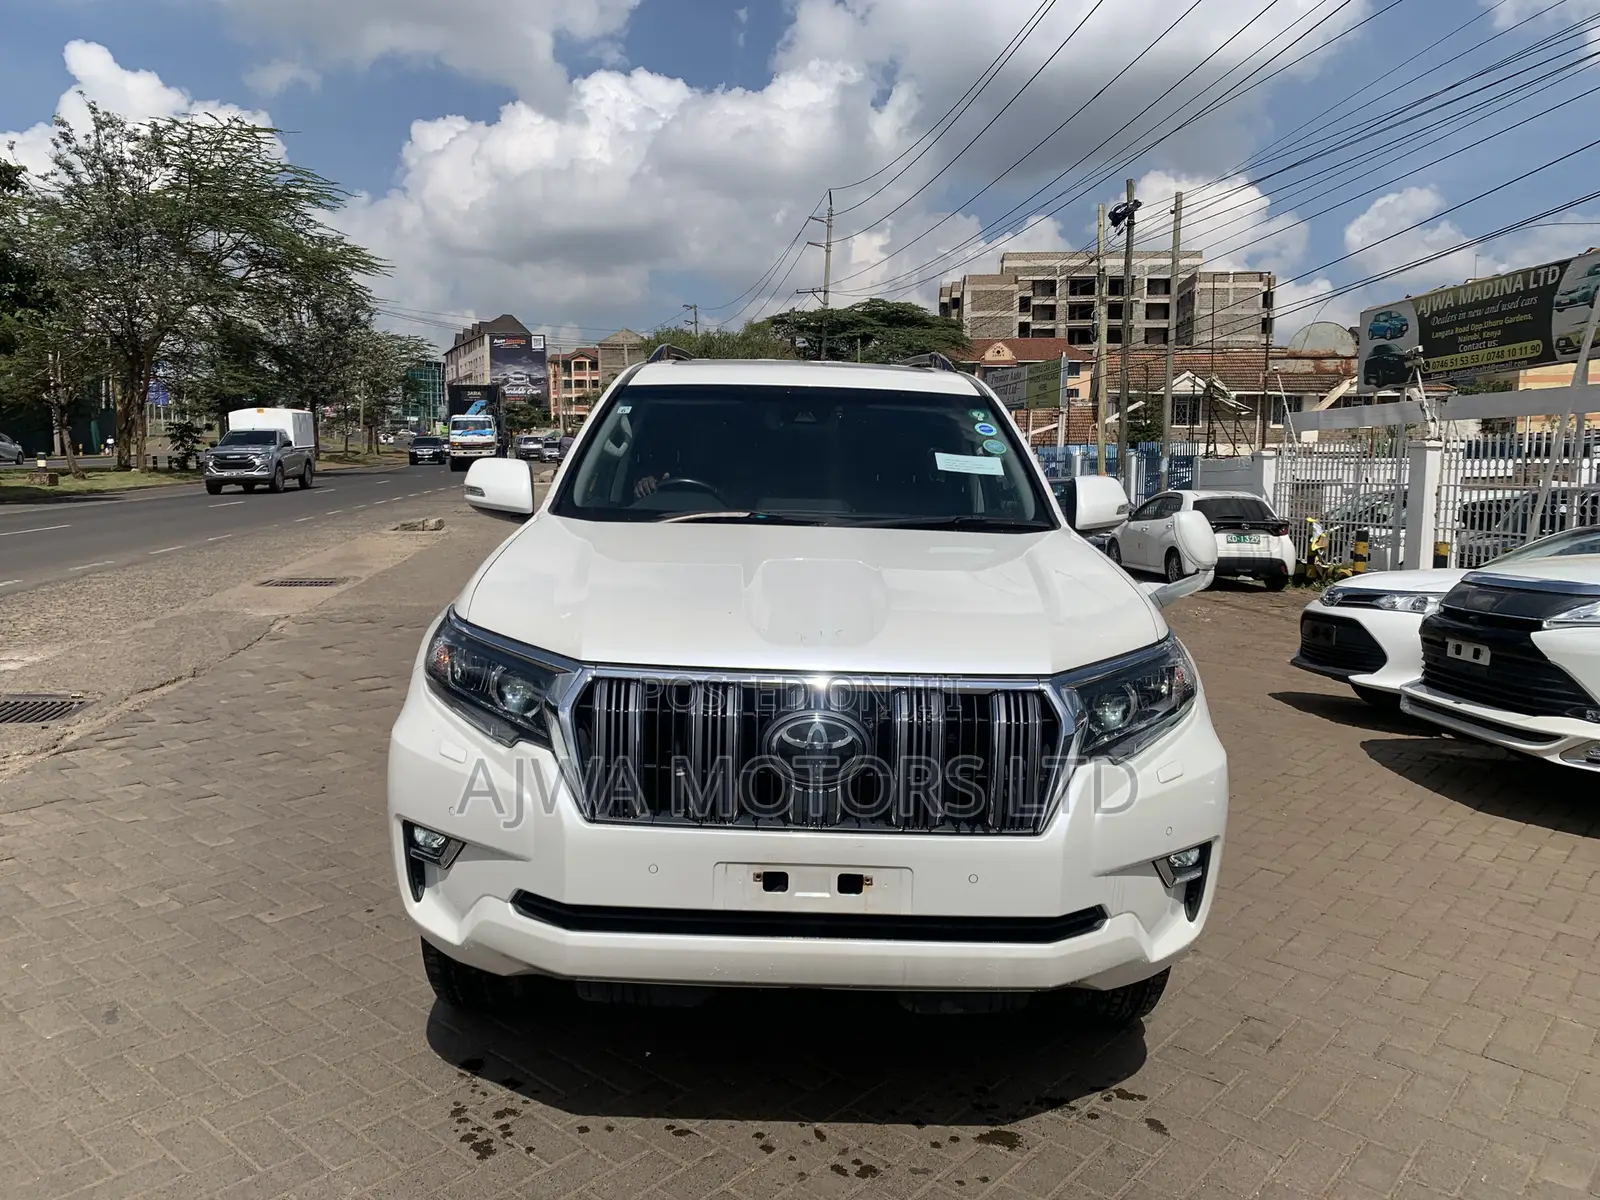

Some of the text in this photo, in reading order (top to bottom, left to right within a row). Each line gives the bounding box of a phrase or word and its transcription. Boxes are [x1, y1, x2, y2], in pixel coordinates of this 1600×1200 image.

[1418, 265, 1560, 317] AJWA MADINA LTD
[1431, 295, 1538, 326] Dealers in new and used cars
[1432, 326, 1453, 339] Langata
[1455, 322, 1469, 333] Road
[1504, 312, 1533, 324] Gardens,
[1457, 329, 1501, 343] Nairobi, Kenya
[1432, 359, 1448, 370] 0746
[1449, 357, 1458, 367] 51
[1460, 356, 1469, 365] 53
[1470, 354, 1479, 363] 53
[1486, 350, 1505, 361] 0748
[1507, 347, 1516, 358] 10
[1519, 346, 1528, 355] 11
[1530, 343, 1540, 354] 90
[1458, 339, 1499, 352] Contact us:
